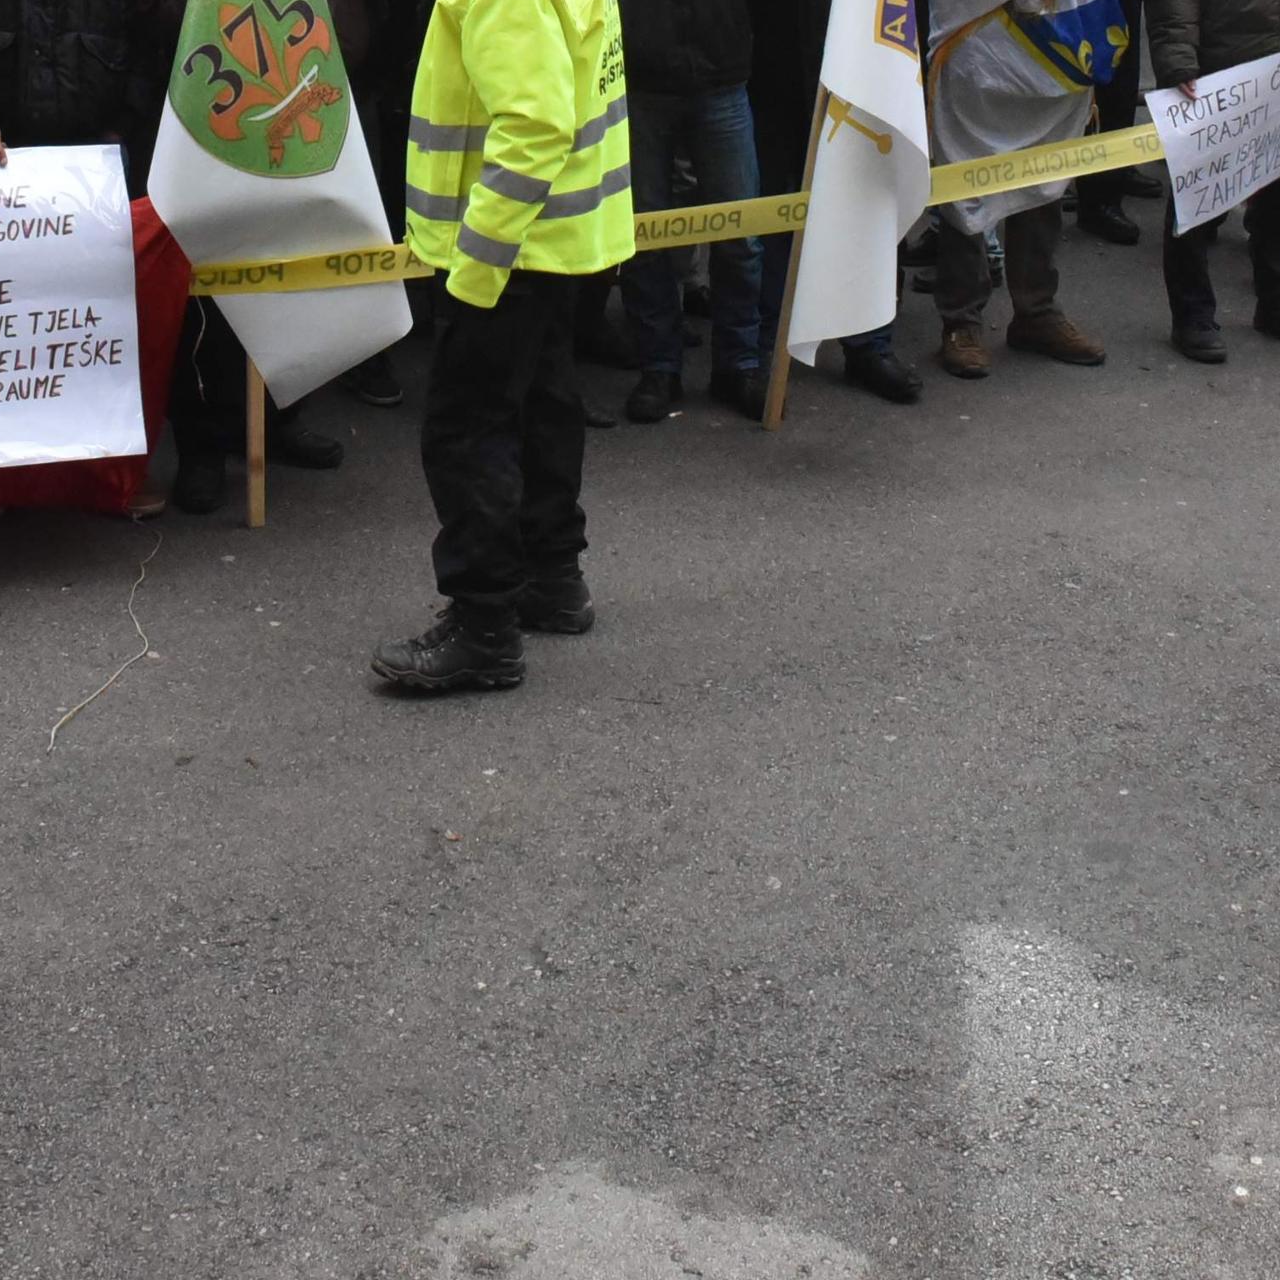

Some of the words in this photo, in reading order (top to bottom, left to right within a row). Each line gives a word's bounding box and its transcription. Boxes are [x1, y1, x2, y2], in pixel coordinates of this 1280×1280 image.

[1166, 78, 1258, 128] PROTESTI
[1190, 104, 1270, 151] TRAJATI
[1175, 167, 1204, 194] DOK
[1208, 153, 1232, 177] NE
[28, 305, 102, 336] TJELA
[46, 333, 124, 371] TEŠKE
